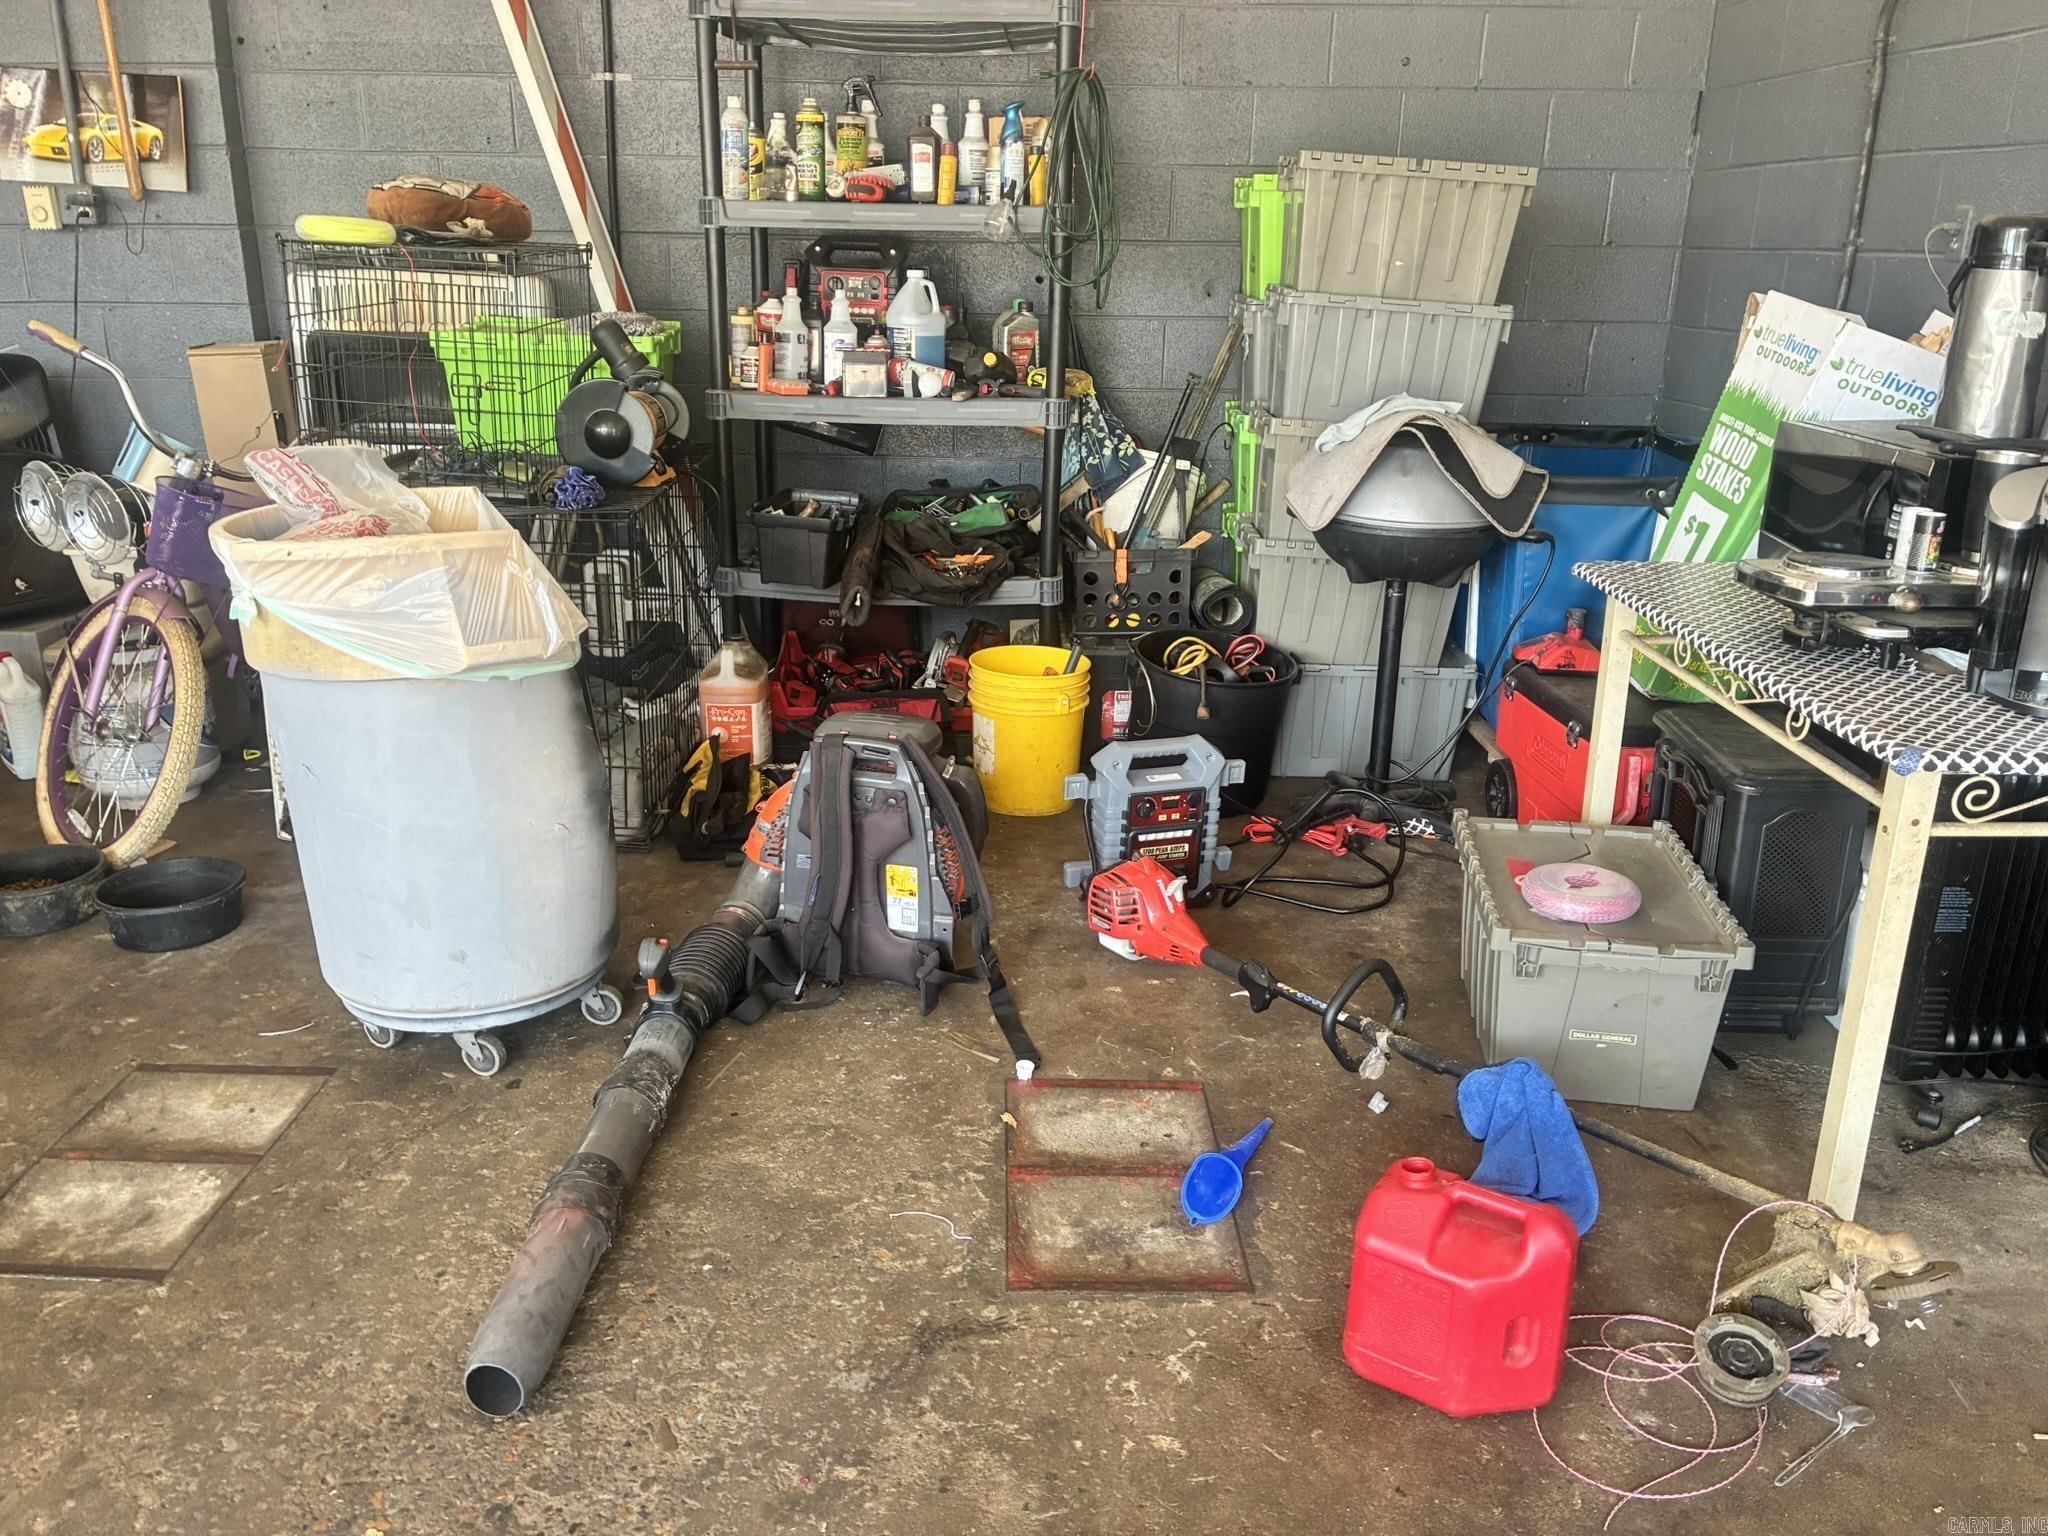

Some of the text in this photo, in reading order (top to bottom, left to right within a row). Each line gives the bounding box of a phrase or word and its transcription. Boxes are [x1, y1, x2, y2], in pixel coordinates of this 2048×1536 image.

[1756, 345, 1810, 376] OUTDOORS
[1837, 378, 1929, 418] OUTDOORS
[1708, 423, 1758, 471] WOOD
[1696, 453, 1752, 505] STAKES
[1601, 1034, 1633, 1042] GENERAL
